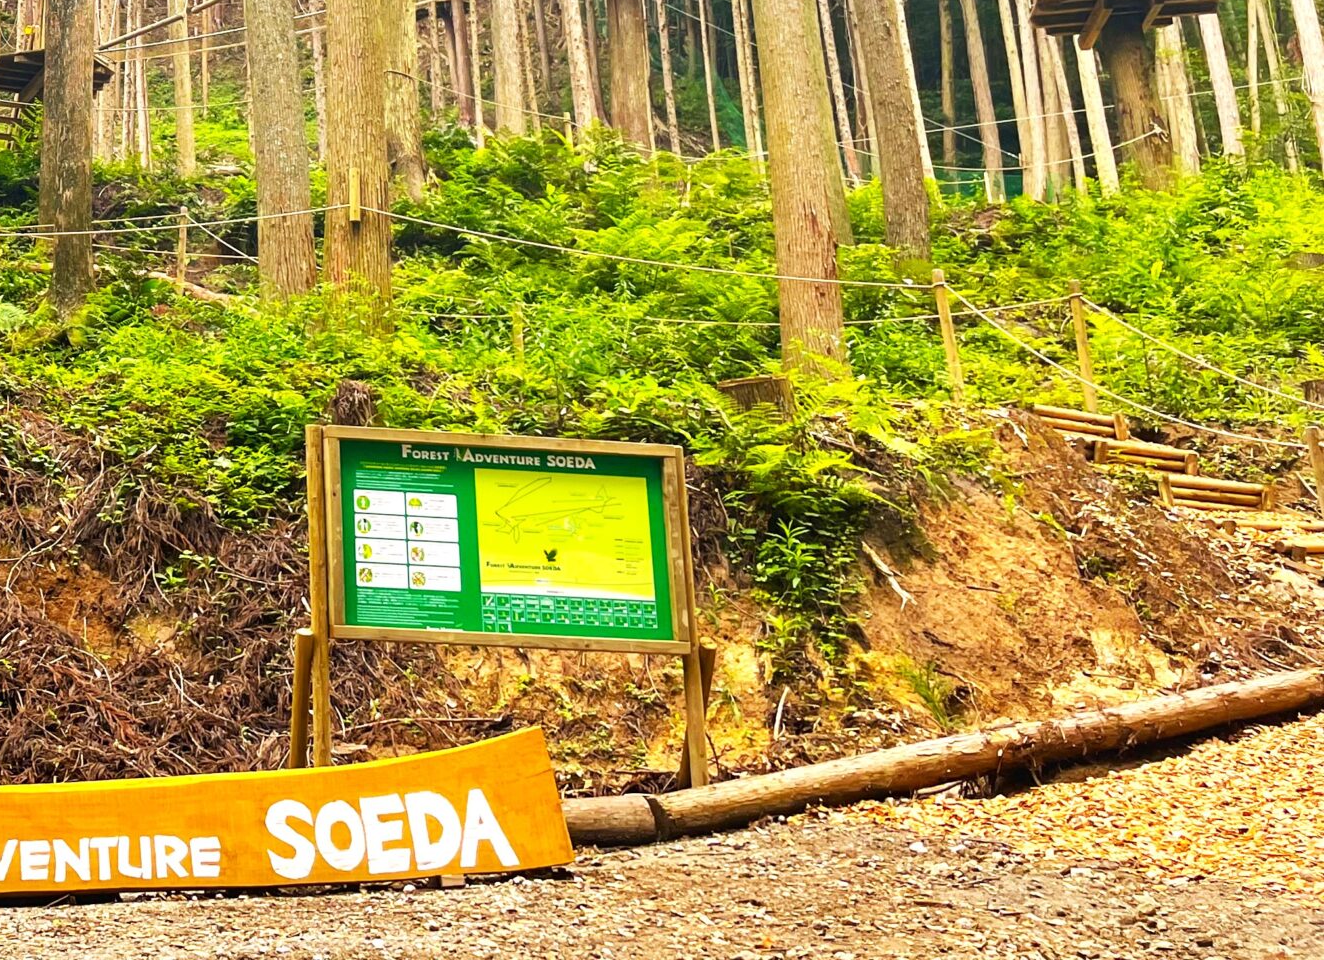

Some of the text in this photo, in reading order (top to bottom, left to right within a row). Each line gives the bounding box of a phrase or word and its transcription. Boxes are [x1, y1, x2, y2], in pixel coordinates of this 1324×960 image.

[401, 444, 450, 461] FOREST
[462, 447, 541, 467] ADVENTURE
[546, 454, 597, 470] SOEDA
[264, 788, 520, 880] SOEDA
